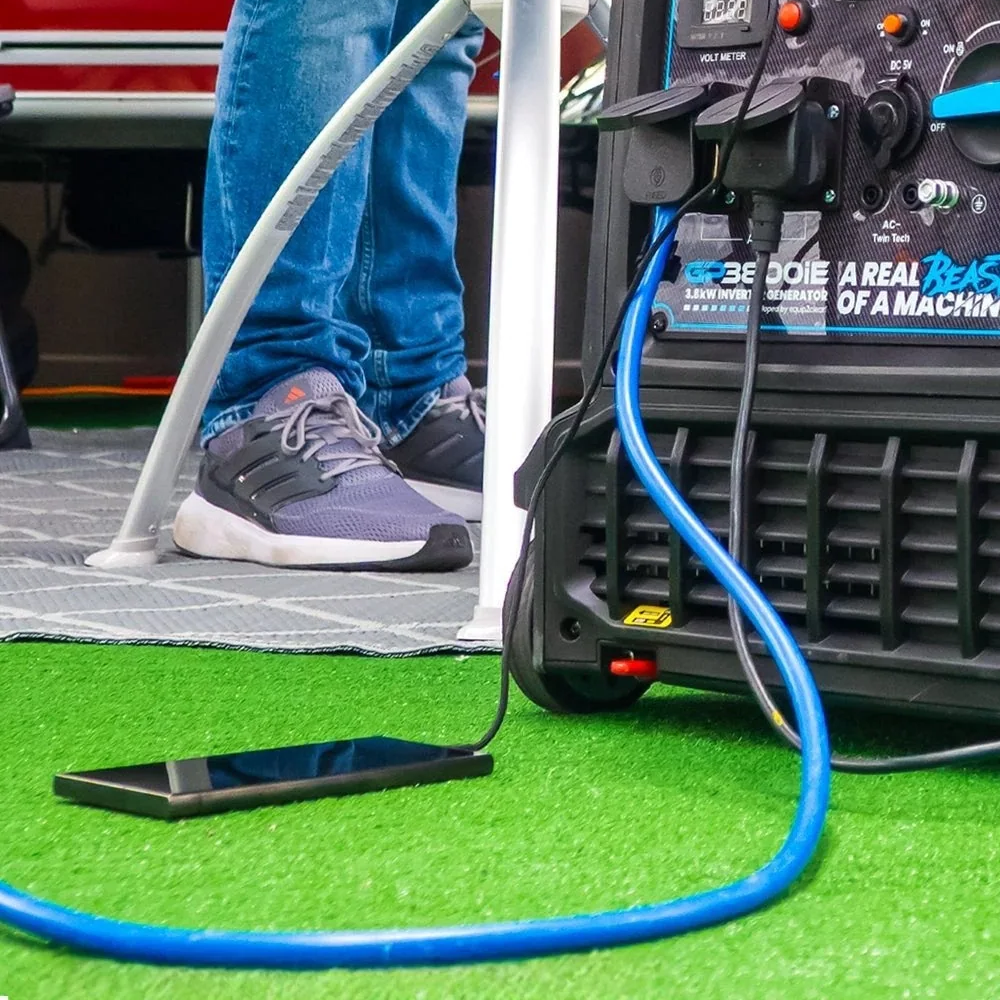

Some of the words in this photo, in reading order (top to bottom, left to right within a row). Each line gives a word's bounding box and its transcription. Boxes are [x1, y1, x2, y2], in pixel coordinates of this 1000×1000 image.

[921, 19, 930, 27] ON
[943, 44, 955, 53] ON
[700, 53, 718, 63] VOLT
[720, 51, 746, 62] METER
[890, 61, 901, 71] DC
[902, 59, 912, 70] 5V
[930, 123, 946, 132] OFF
[872, 234, 889, 243] Twin
[892, 233, 910, 243] Tech
[838, 261, 857, 287] A
[861, 261, 920, 287] REAL
[684, 288, 715, 300] 3.8kW
[717, 289, 762, 300] INVERT
[767, 289, 829, 301] GENERATOR
[837, 290, 871, 316] OF
[870, 290, 889, 316] A
